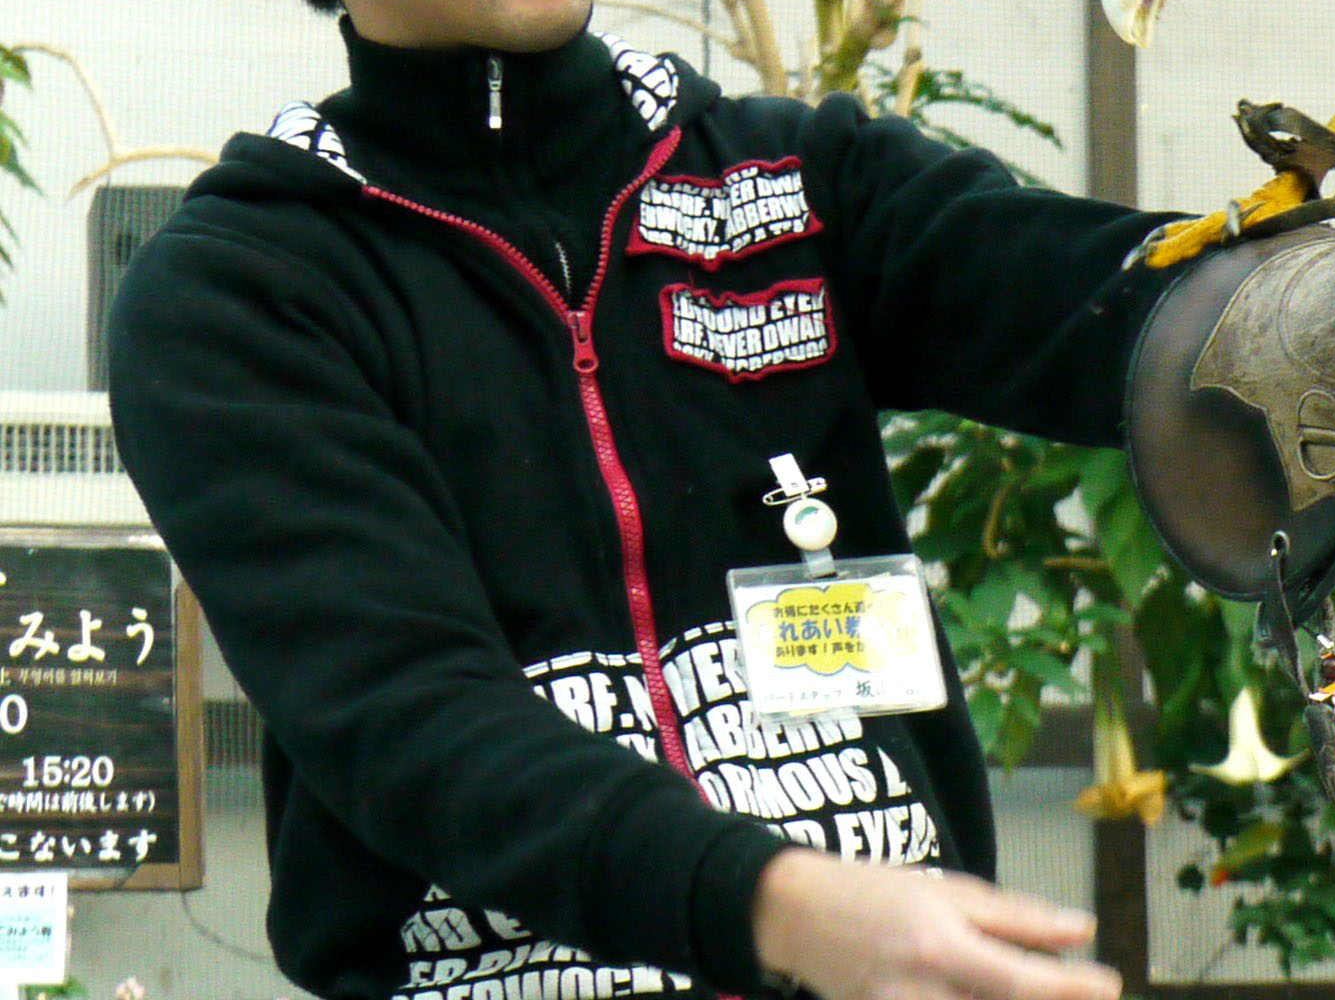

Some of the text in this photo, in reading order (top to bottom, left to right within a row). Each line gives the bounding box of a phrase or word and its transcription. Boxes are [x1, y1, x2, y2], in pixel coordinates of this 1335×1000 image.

[9, 607, 154, 666] みよう
[22, 755, 114, 788] 15:20
